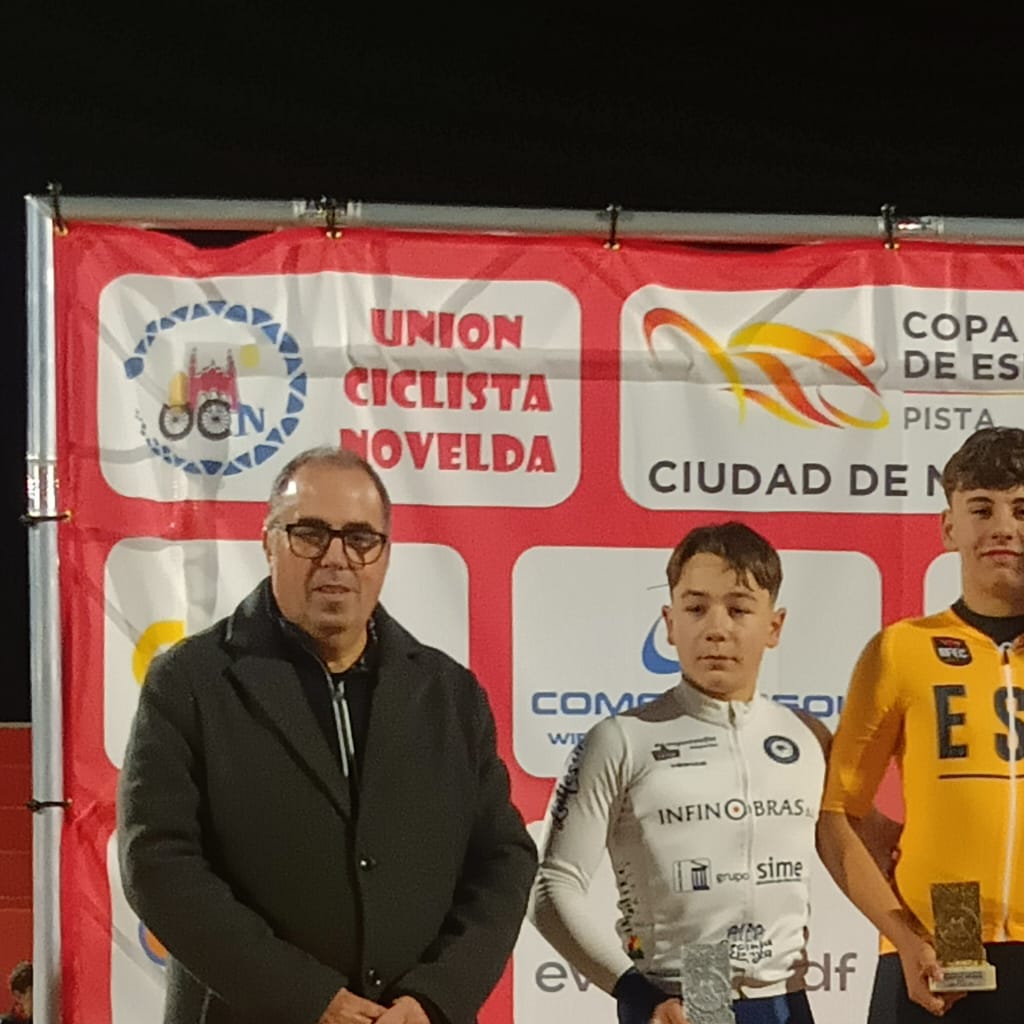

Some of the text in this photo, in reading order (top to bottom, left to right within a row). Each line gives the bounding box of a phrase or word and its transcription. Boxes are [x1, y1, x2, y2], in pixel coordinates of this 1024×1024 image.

[370, 309, 524, 350] UNION
[902, 311, 1018, 342] COPA
[904, 351, 957, 380] DE
[343, 368, 553, 413] CICLISTA
[904, 407, 995, 431] PISTA
[339, 429, 557, 473] NOVELDA
[649, 460, 832, 495] CIUDAD
[849, 464, 909, 497] DE
[716, 857, 803, 884] grupo sime
